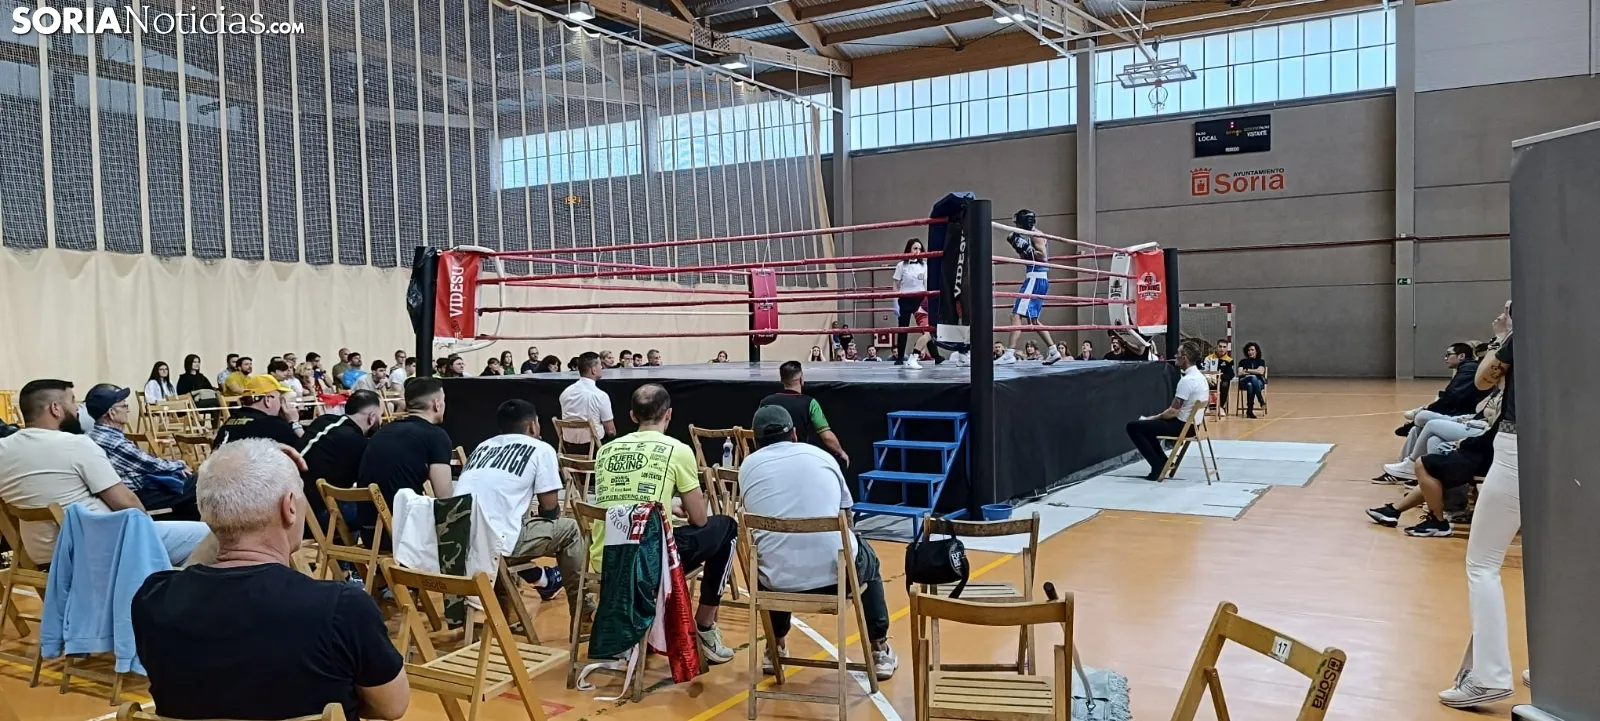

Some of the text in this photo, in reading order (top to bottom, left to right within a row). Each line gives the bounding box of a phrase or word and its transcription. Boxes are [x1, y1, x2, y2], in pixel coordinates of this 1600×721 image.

[1214, 172, 1285, 195] Soria
[1233, 167, 1285, 177] AYUNTAMIENTO
[449, 265, 465, 318] VIDESU
[489, 443, 537, 478] BITCH
[607, 460, 643, 472] BOXING
[609, 452, 644, 461] PUEBLO
[608, 507, 629, 534] BOXEO
[1278, 642, 1288, 655] 17
[1311, 669, 1337, 709] Soria
